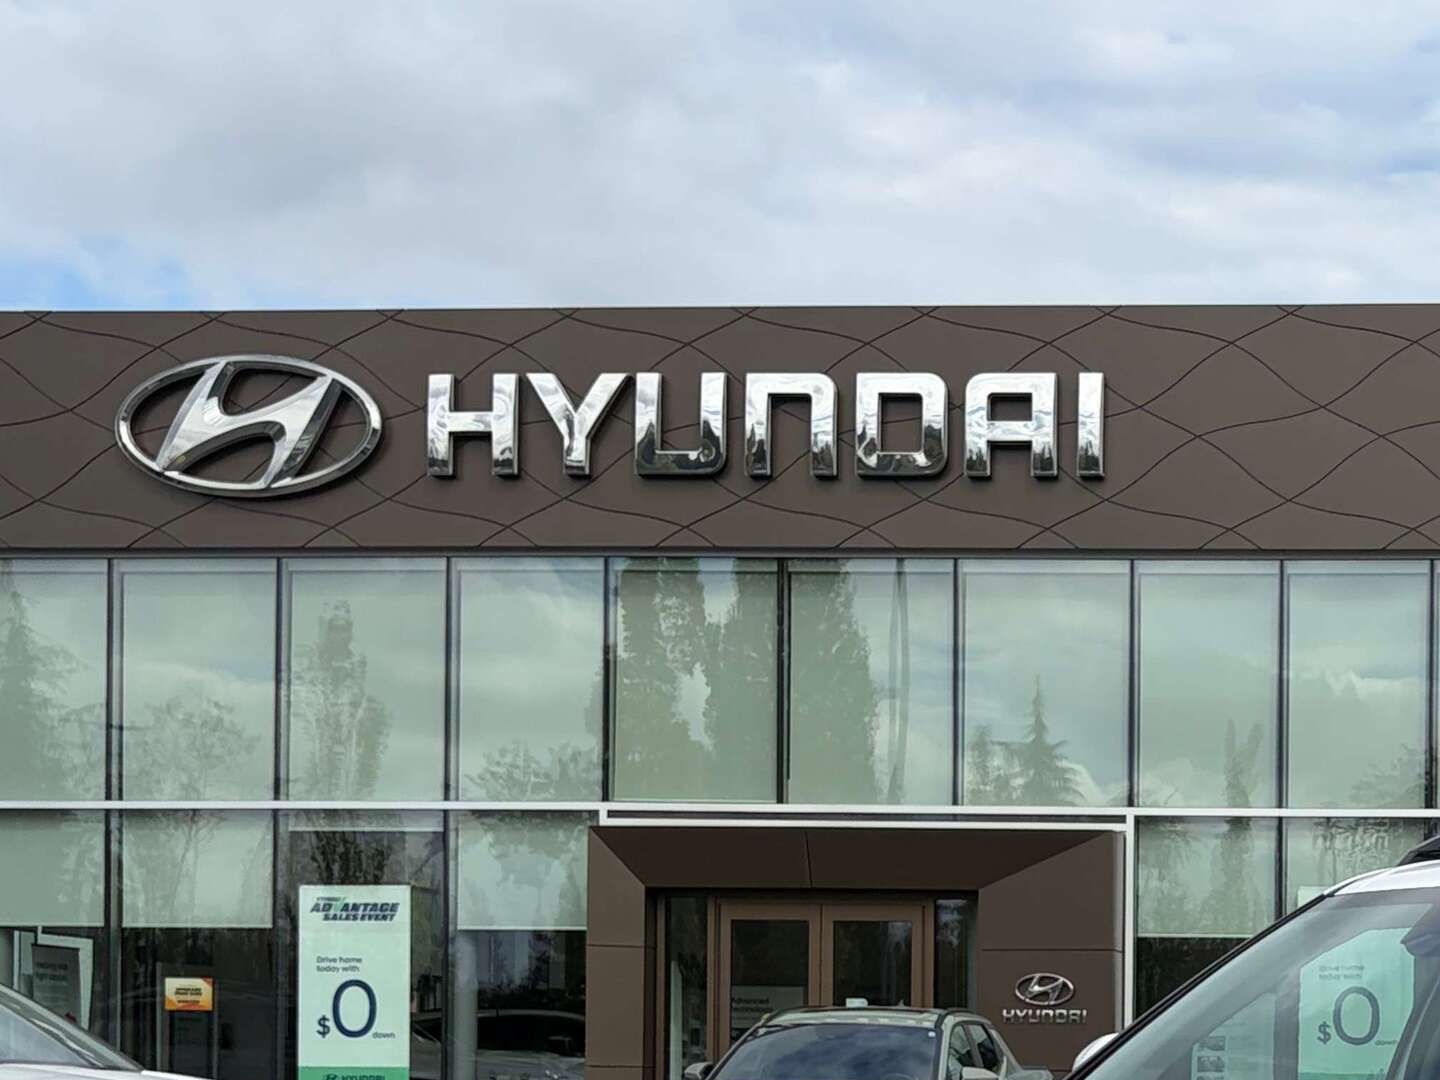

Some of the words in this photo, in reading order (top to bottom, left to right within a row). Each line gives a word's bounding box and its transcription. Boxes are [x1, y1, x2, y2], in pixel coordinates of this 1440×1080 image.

[427, 371, 1105, 479] HYUNDAI
[310, 902, 400, 912] ADVANTAGE
[323, 913, 358, 922] SALES
[359, 913, 396, 922] EVENT
[316, 965, 339, 973] today
[1001, 1008, 1088, 1024] HYUNDAI
